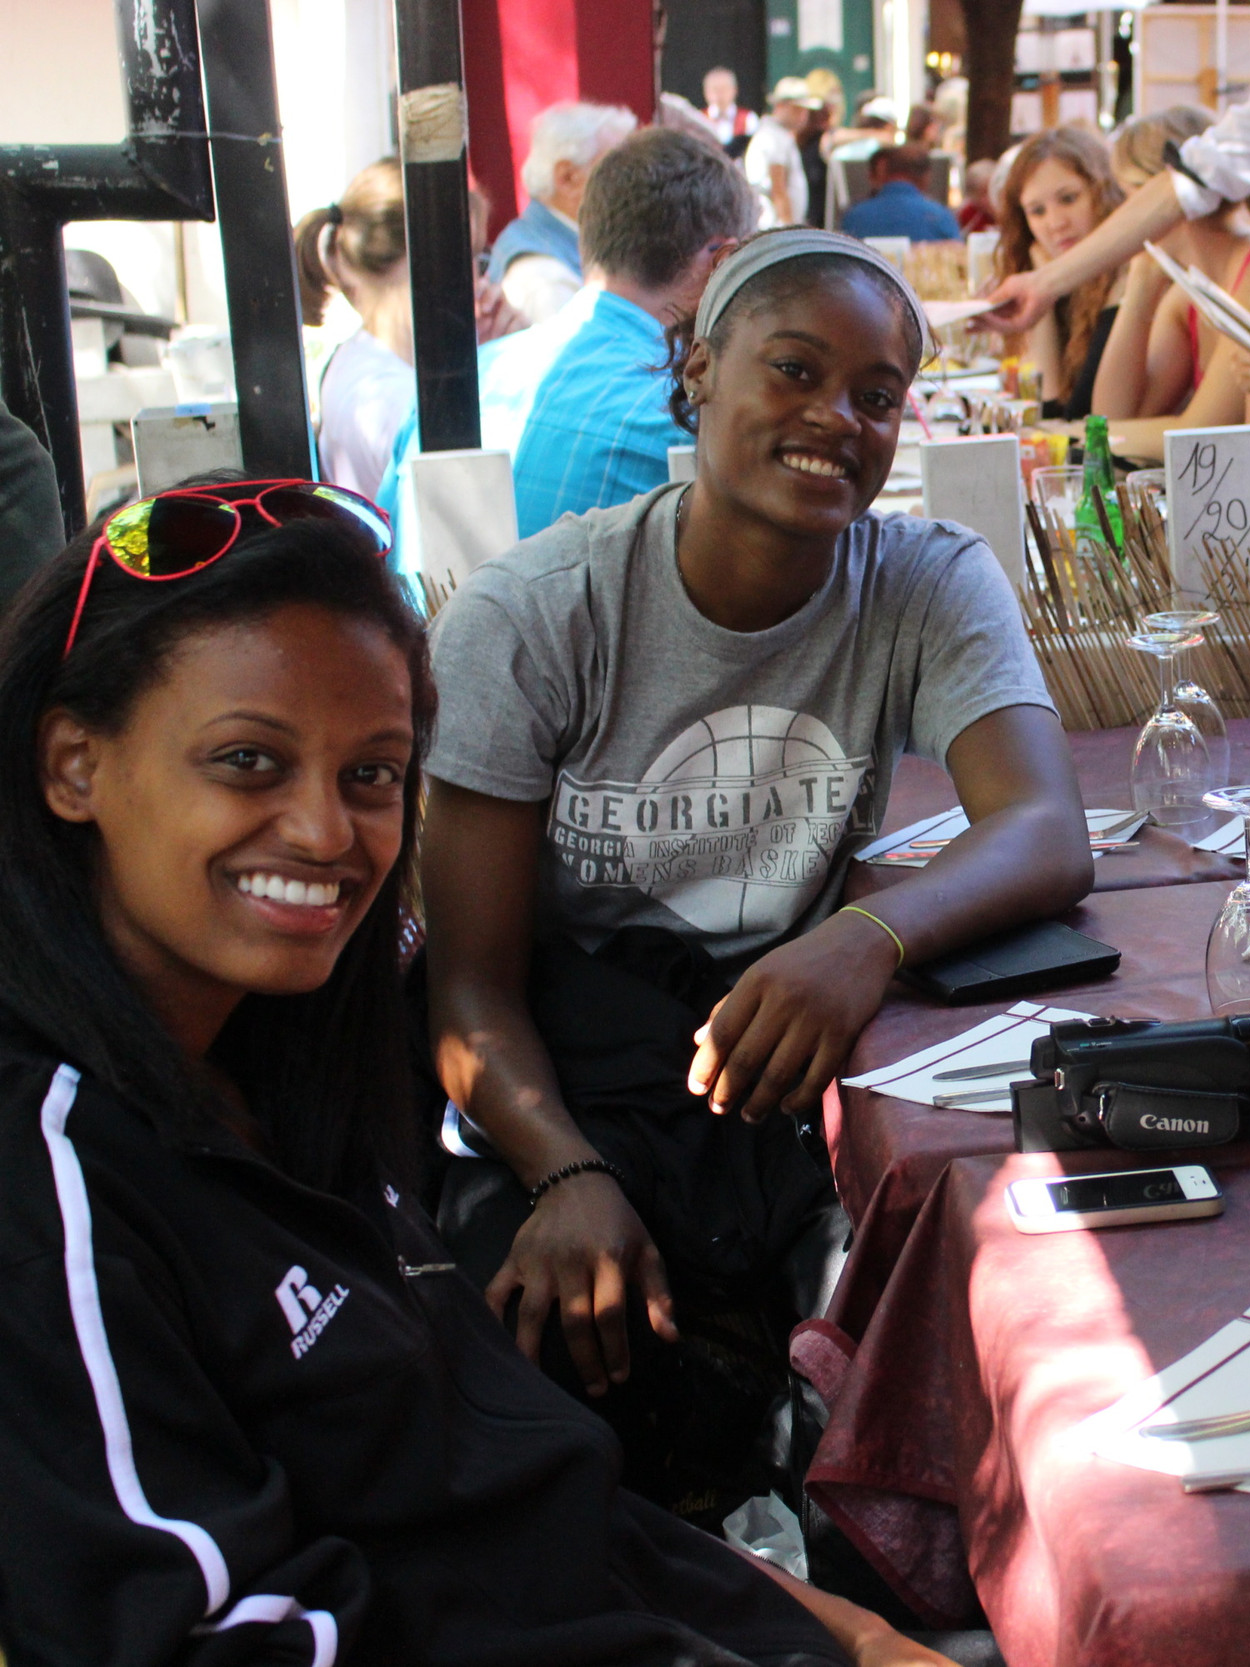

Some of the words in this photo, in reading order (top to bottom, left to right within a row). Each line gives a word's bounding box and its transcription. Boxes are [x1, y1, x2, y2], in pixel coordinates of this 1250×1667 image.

[567, 785, 784, 832] GEORGIA
[553, 825, 636, 859] GEORGIA
[648, 828, 759, 860] INSTITUTE
[769, 822, 797, 845] OF
[1139, 1113, 1210, 1135] Canon
[290, 1283, 350, 1360] RUSSELL
